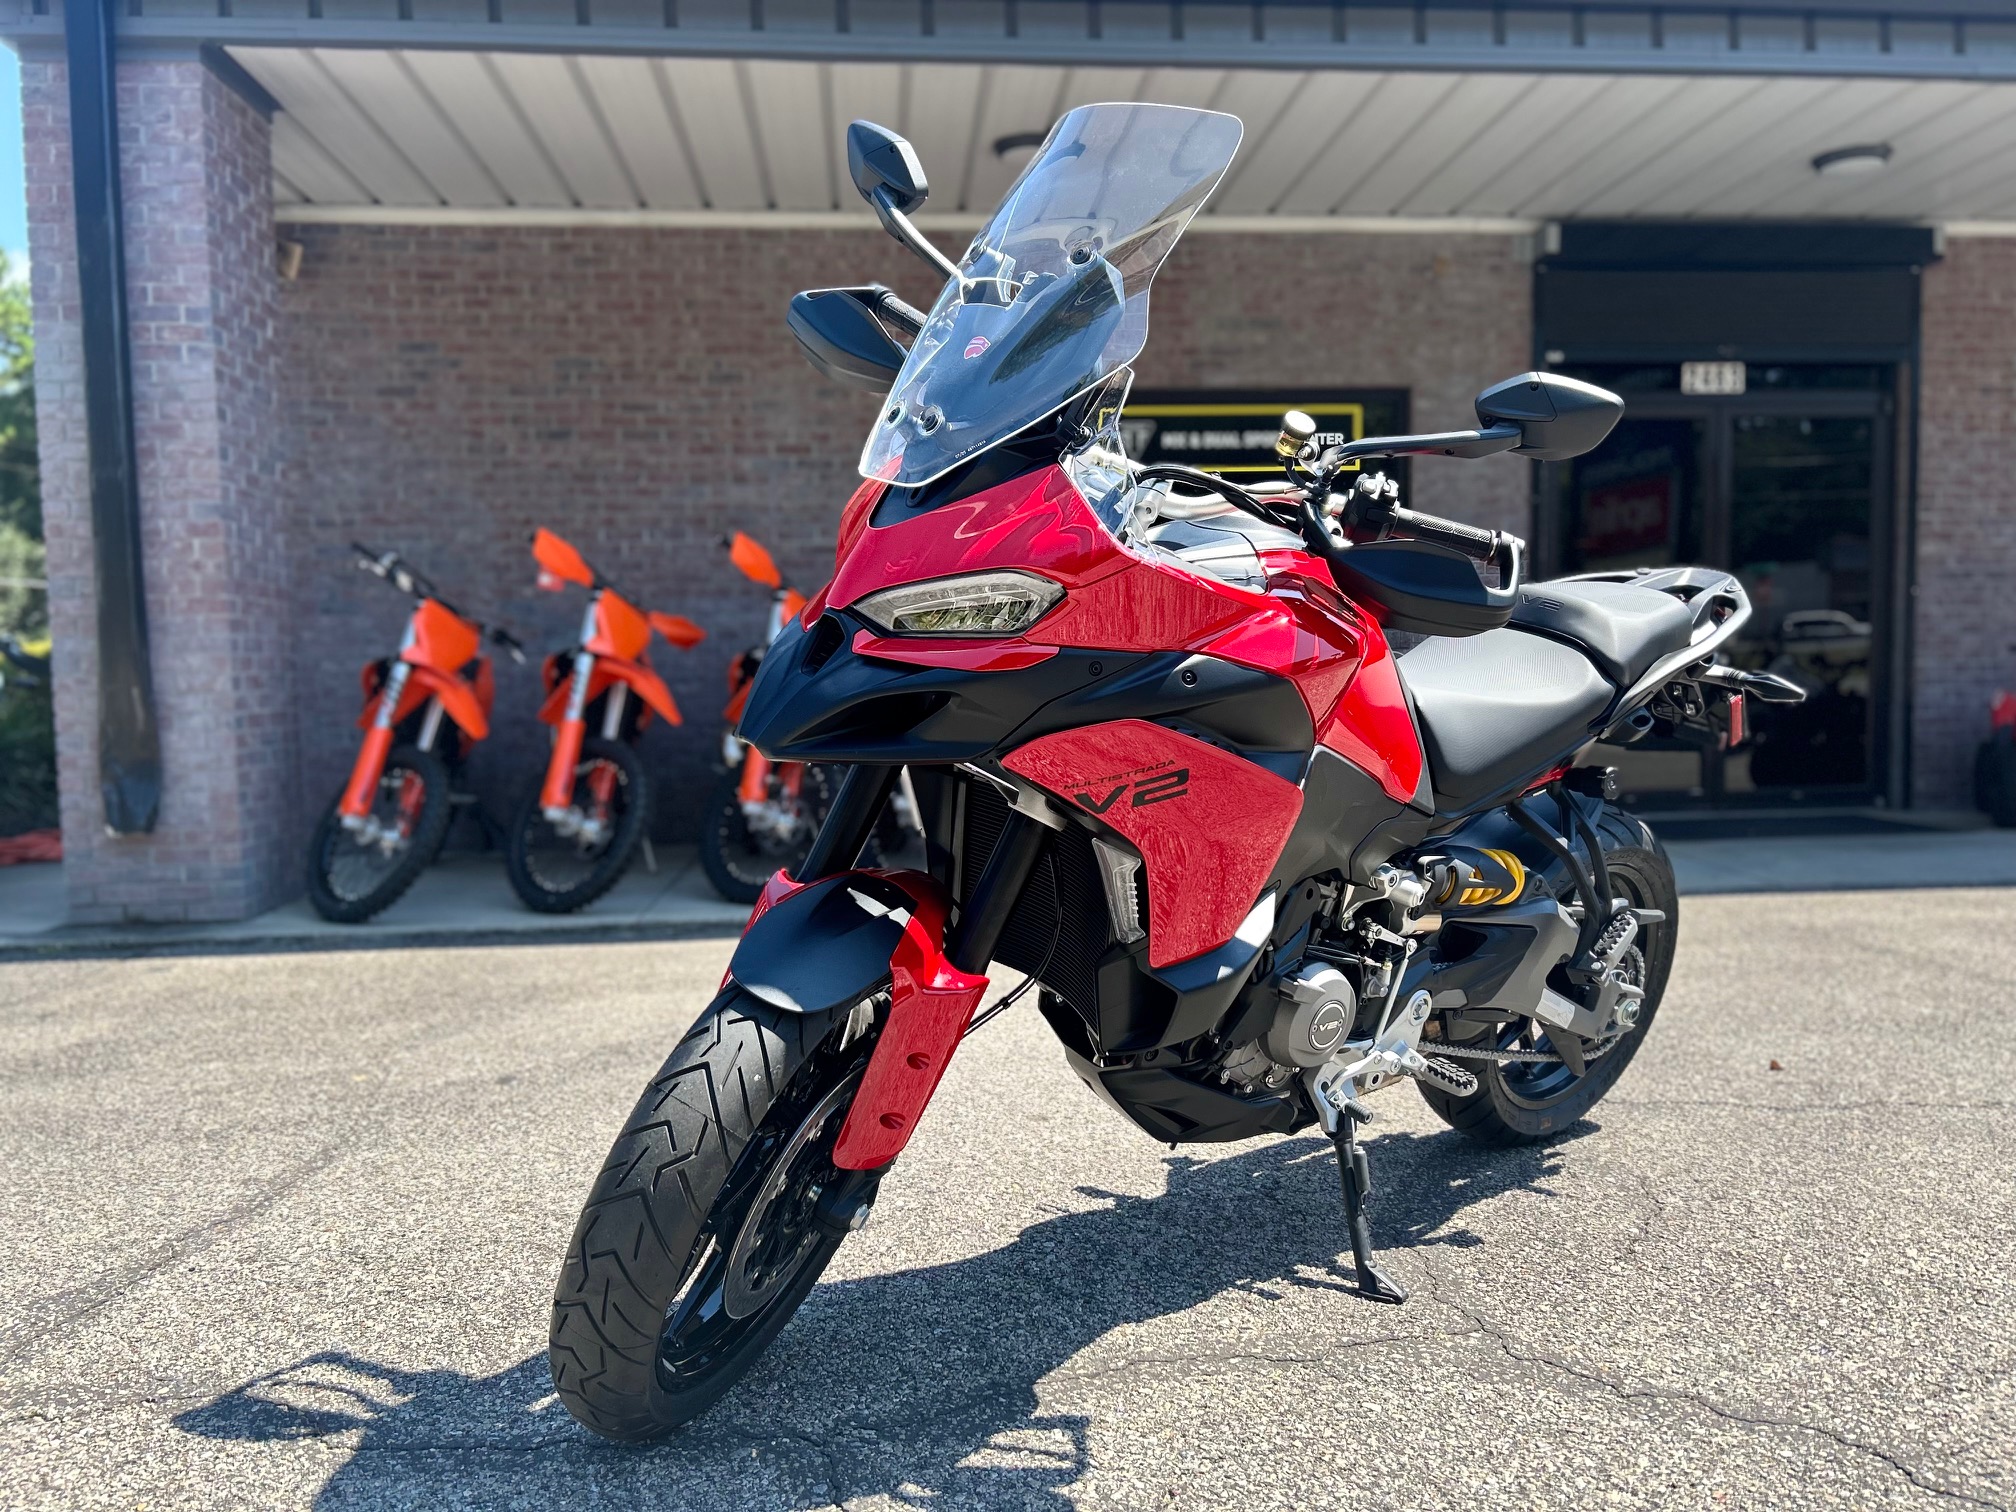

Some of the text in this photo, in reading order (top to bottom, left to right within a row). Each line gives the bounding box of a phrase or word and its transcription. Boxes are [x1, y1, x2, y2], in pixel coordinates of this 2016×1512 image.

[1201, 431, 1239, 449] DUAL
[1310, 432, 1344, 446] NTER
[1521, 593, 1565, 612] V2
[1063, 759, 1176, 791] MULTISTRADA
[1073, 768, 1189, 815] V2
[1319, 1021, 1338, 1032] V2
